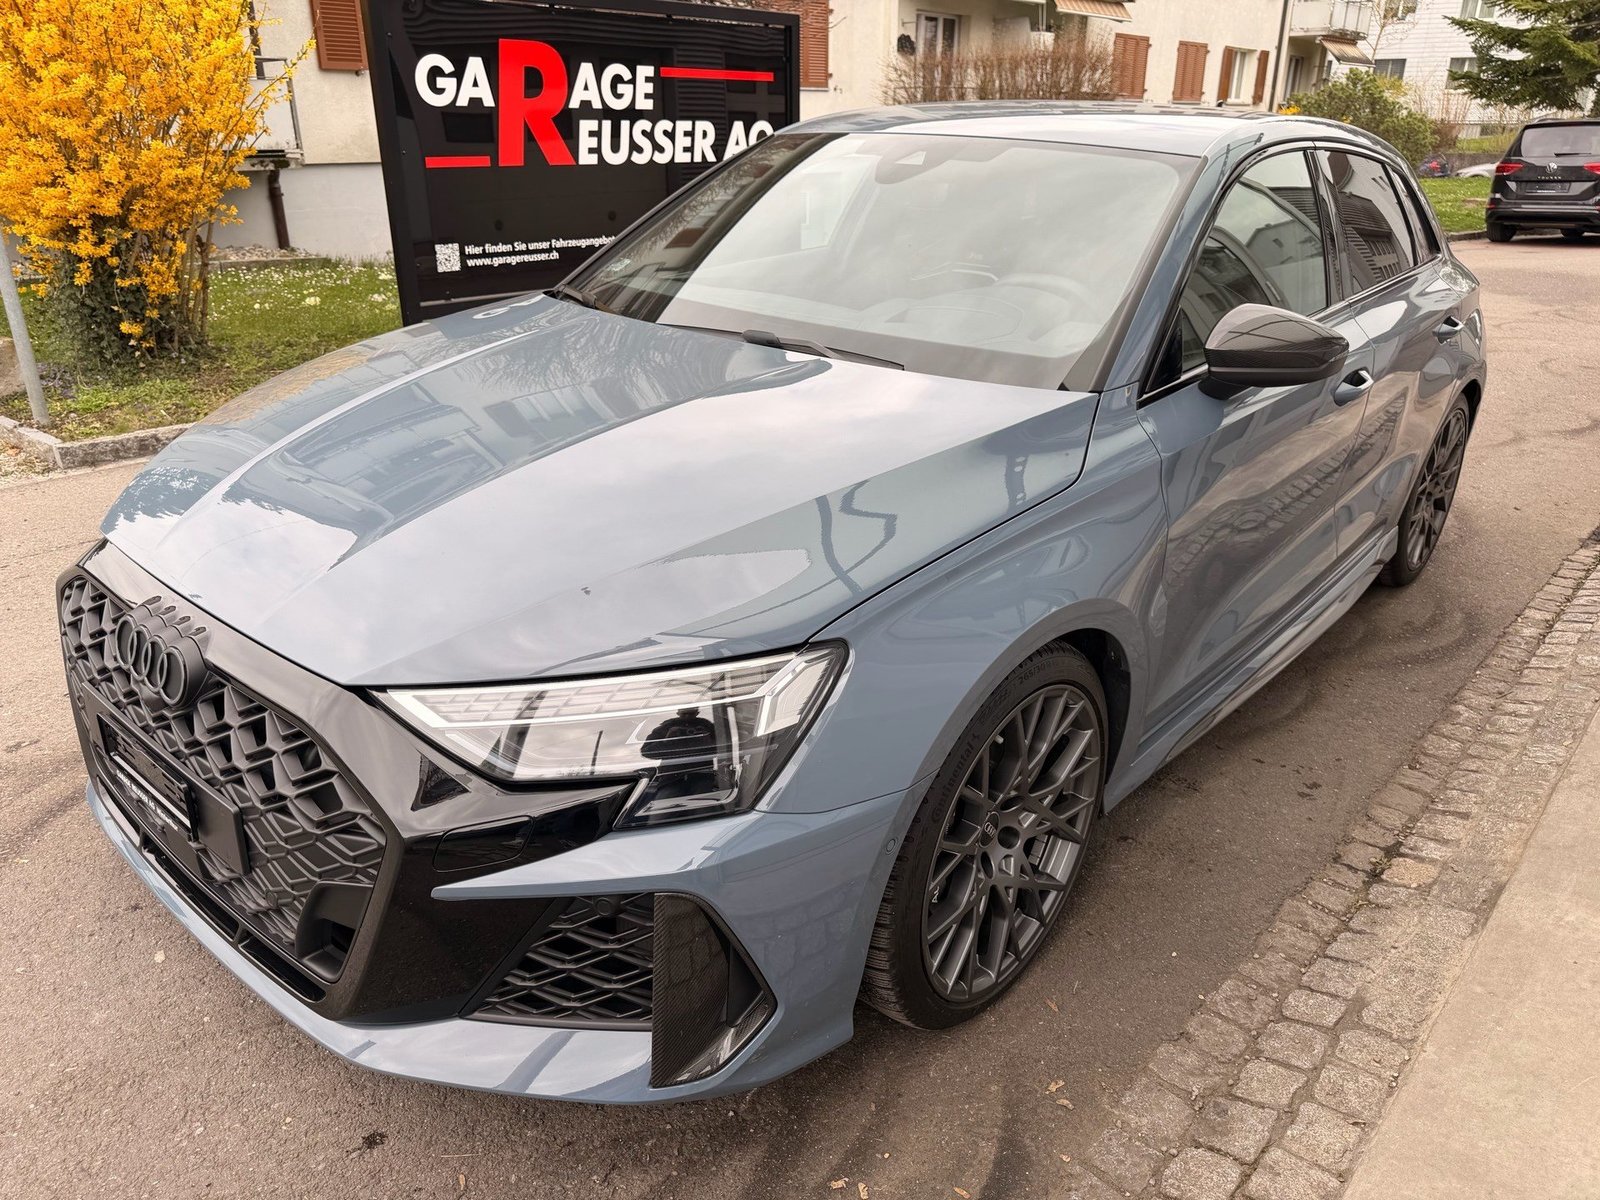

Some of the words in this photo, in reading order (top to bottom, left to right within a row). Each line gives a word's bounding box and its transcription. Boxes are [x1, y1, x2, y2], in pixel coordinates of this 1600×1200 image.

[465, 244, 483, 255] Hier
[485, 241, 513, 253] finden
[514, 239, 527, 250] Sie
[528, 240, 550, 250] unser
[467, 251, 559, 266] www.garagereusser.ch
